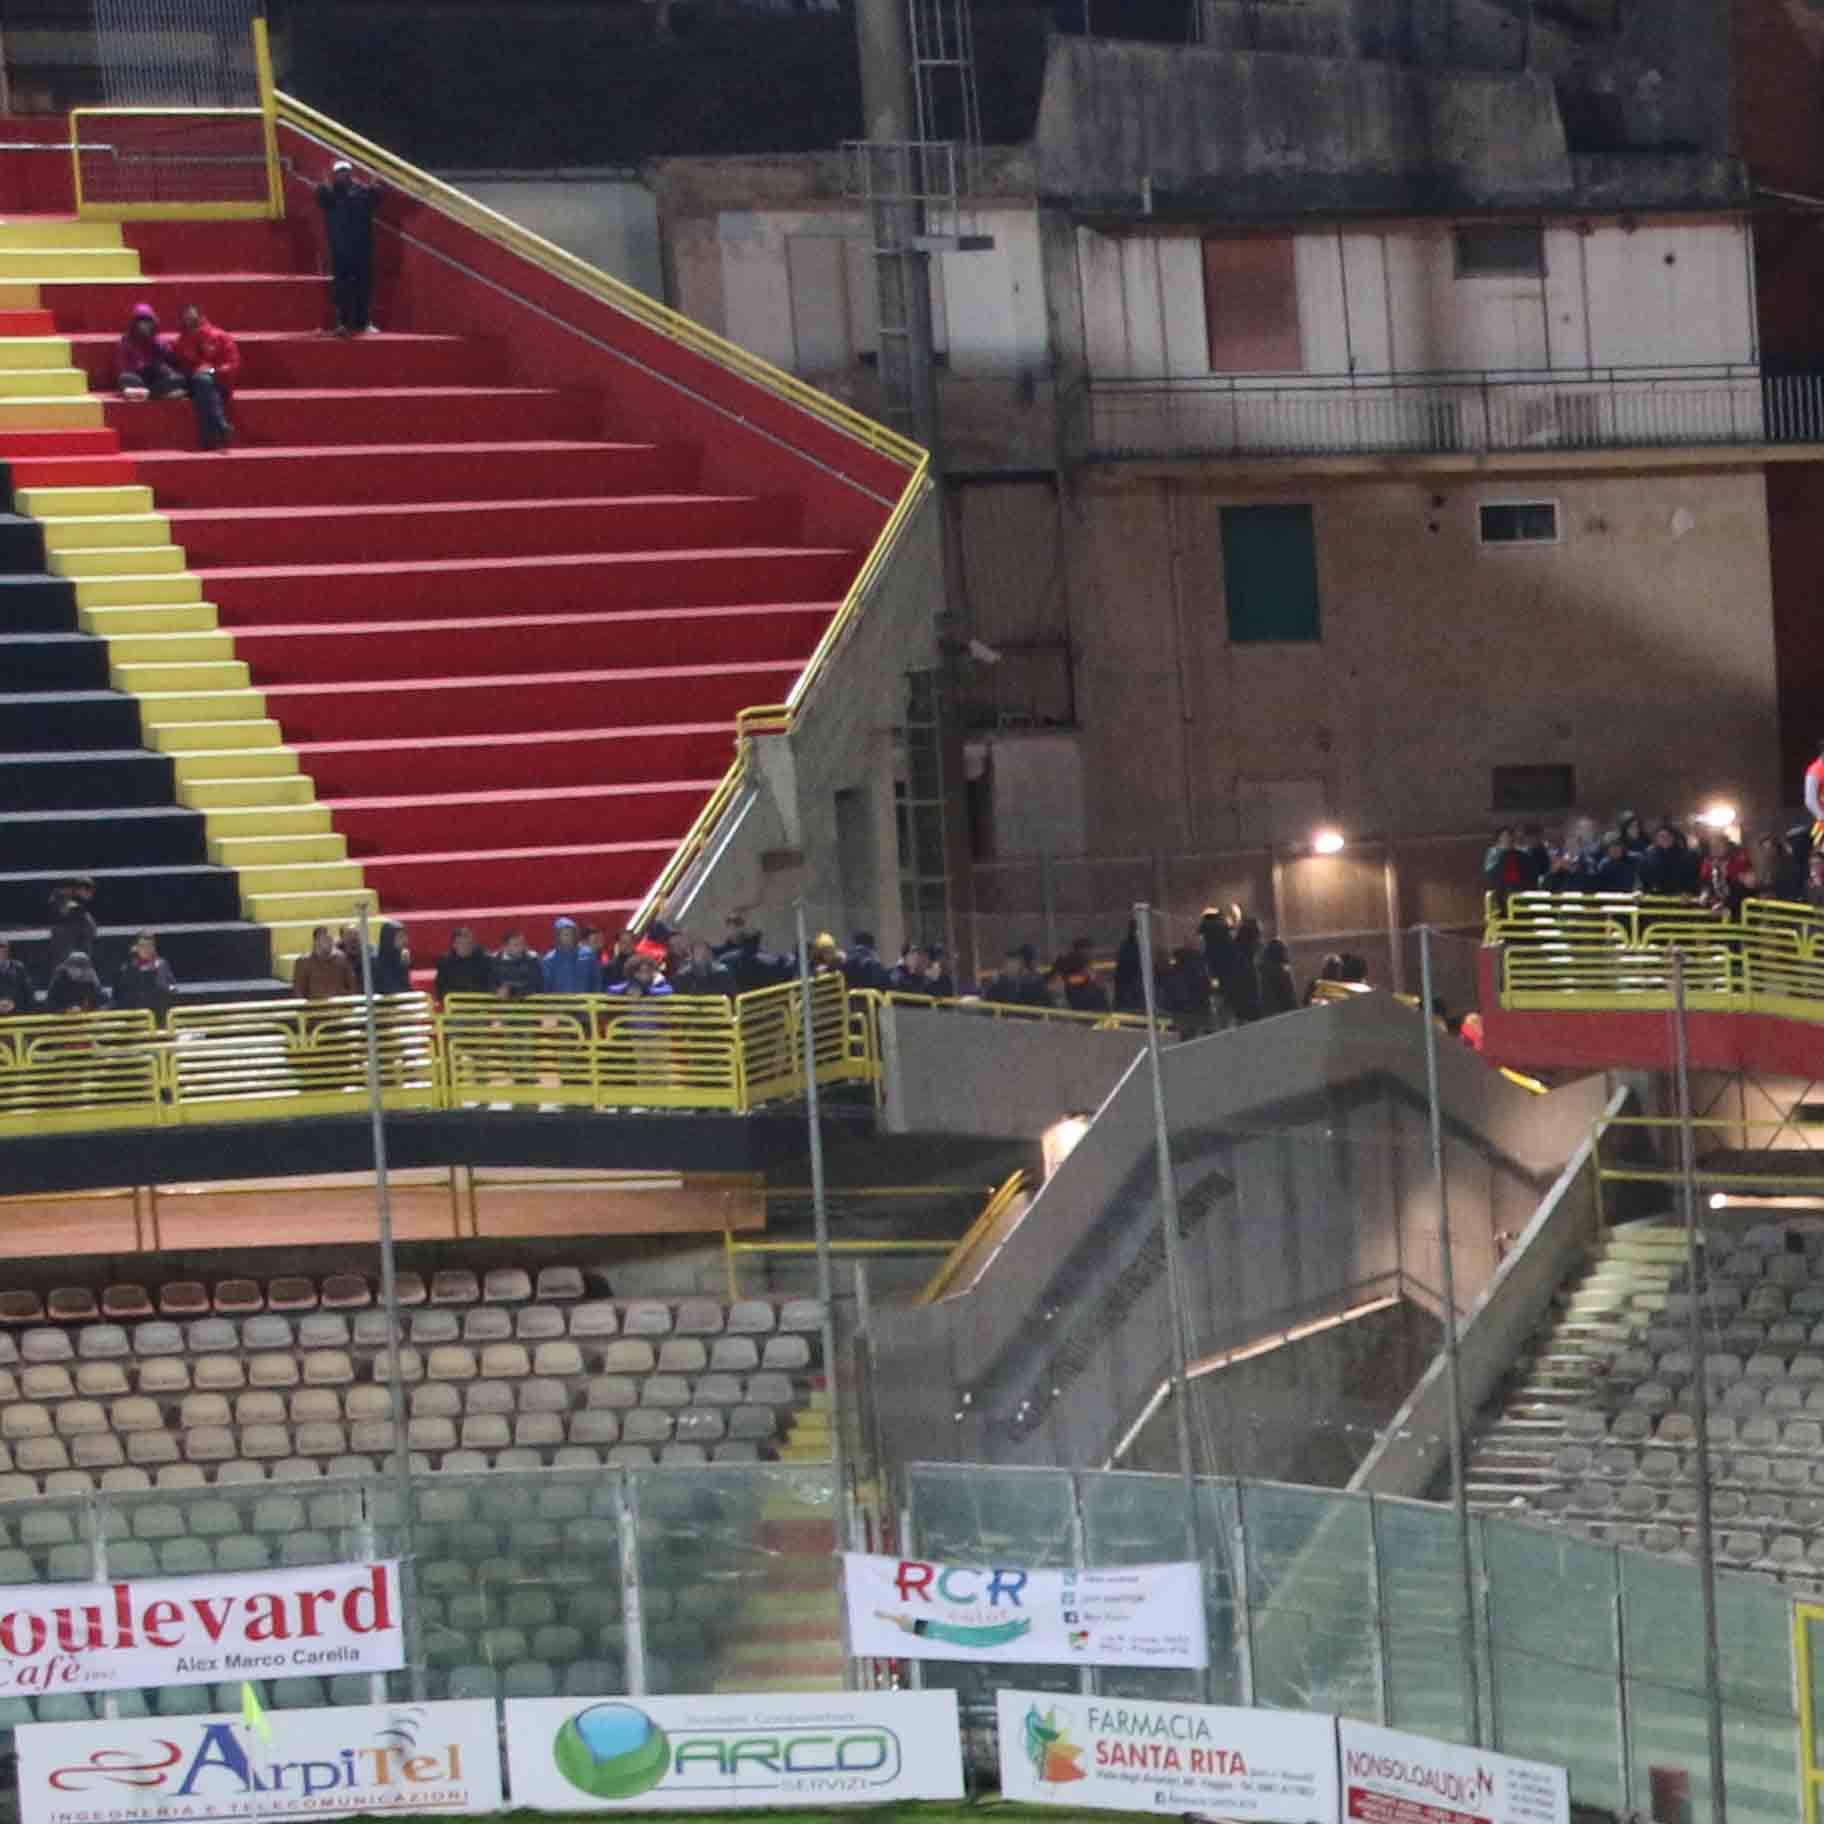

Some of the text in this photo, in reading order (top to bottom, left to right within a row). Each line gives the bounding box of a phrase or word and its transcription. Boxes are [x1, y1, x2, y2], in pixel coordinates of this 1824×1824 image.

[895, 1560, 1029, 1607] RCR
[0, 1565, 398, 1657] oulevard
[176, 1646, 361, 1673] Alex Marco Carella
[1088, 1707, 1212, 1741] FARMACIA
[168, 1722, 464, 1796] ArpiTel
[675, 1735, 888, 1775] ARCO
[1096, 1740, 1247, 1776] SANTA RITA
